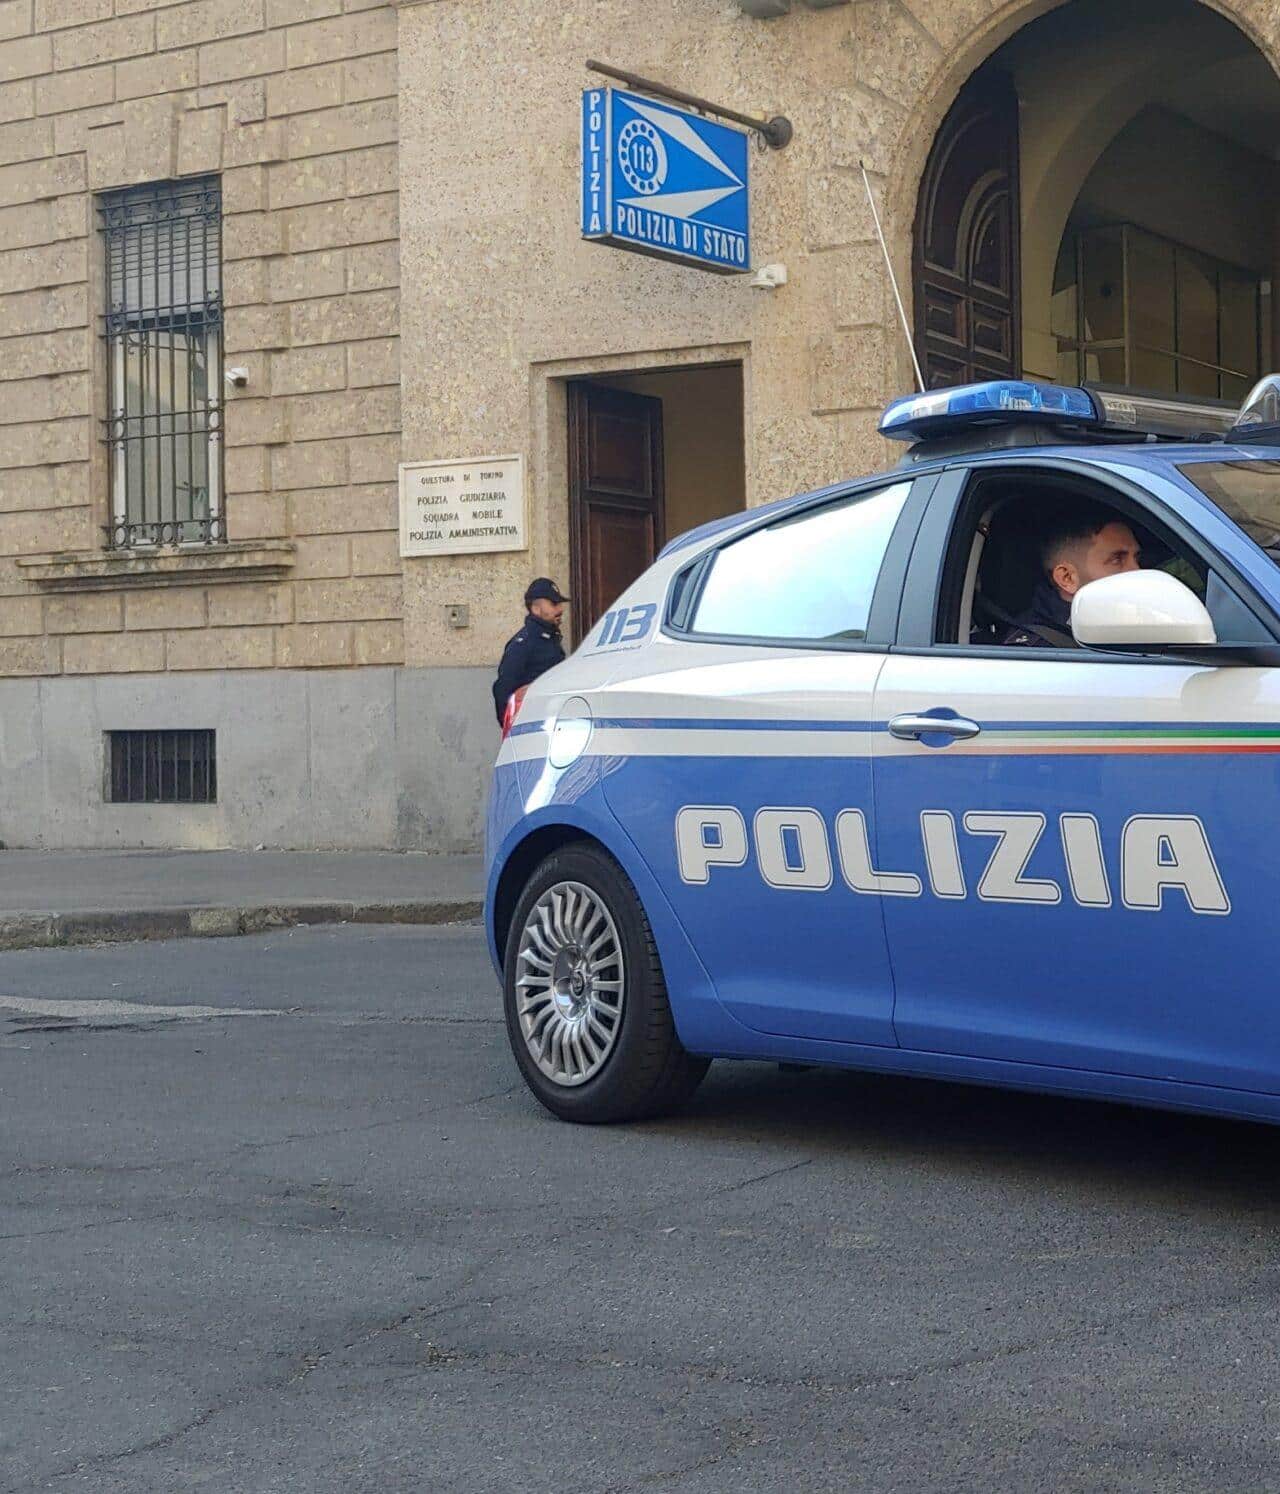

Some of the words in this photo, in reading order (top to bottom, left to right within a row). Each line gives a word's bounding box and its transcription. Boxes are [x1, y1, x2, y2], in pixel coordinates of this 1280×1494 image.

[589, 92, 601, 231] POLIZIA
[632, 142, 654, 174] 113
[617, 205, 677, 246] POLIZIA
[683, 228, 697, 251] DI
[703, 230, 746, 263] STATO
[421, 475, 455, 485] QUESTURA
[480, 472, 504, 481] TORINO
[417, 495, 449, 506] POLIZIA
[459, 491, 506, 503] GIUDIZIARIA
[423, 512, 460, 524] SQUADRA
[472, 509, 503, 520] MOBILE
[409, 530, 443, 541] POLIZIA
[449, 526, 518, 539] AMMINISTRATIVA
[596, 602, 658, 648] 113
[675, 804, 1232, 915] POLIZIA
